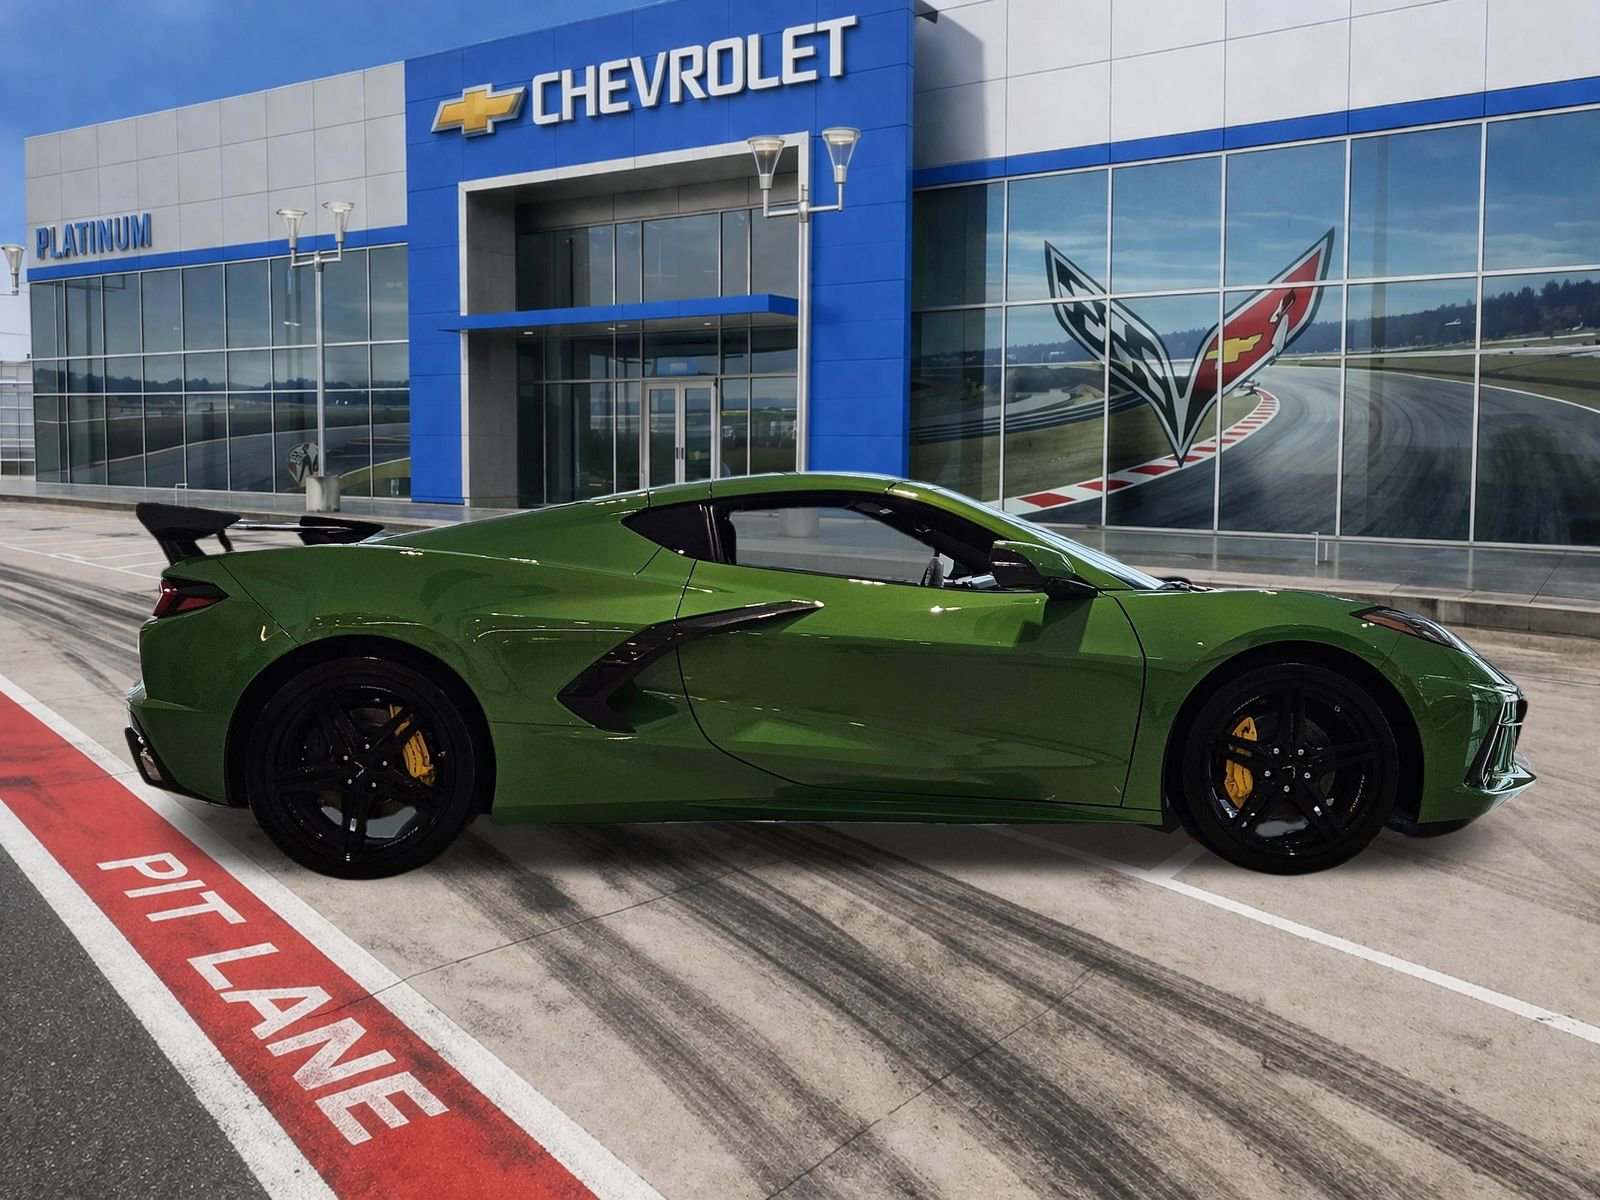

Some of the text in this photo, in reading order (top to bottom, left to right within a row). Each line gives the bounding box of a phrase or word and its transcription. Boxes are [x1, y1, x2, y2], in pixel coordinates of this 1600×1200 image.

[532, 15, 858, 126] CHEVROLET
[35, 213, 152, 260] PLATINUM
[96, 852, 450, 1146] PIT LANE
